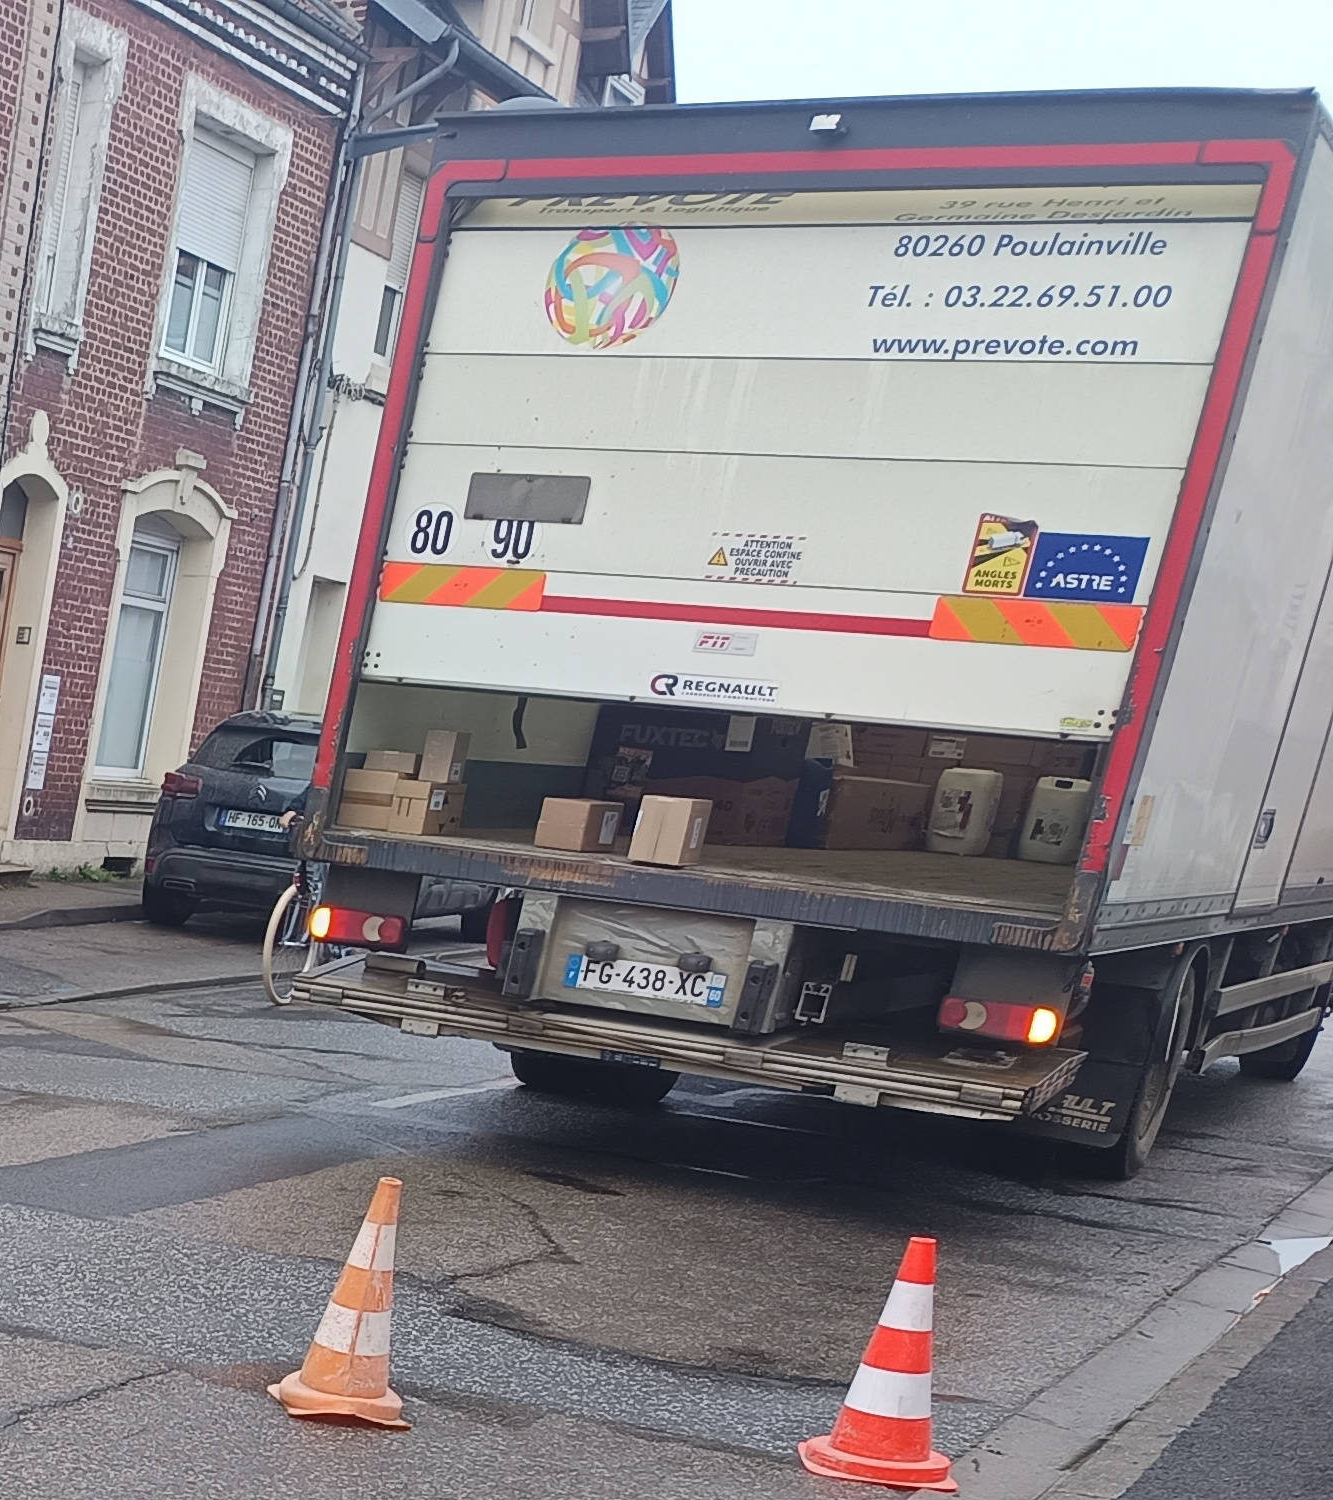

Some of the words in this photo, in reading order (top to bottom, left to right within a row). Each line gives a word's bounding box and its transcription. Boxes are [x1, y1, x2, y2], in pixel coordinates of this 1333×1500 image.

[983, 199, 1033, 209] rue
[1042, 196, 1127, 208] Henri
[1047, 207, 1193, 222] Desjardin
[893, 234, 985, 258] 80260
[992, 231, 1168, 257] Poulainville
[866, 285, 911, 308] Tél.
[924, 292, 934, 308] :
[944, 285, 1173, 308] 03.22.69.51.00
[871, 335, 1139, 359] www.prevote.com
[410, 509, 454, 556] 80
[491, 519, 535, 560] 90
[743, 539, 793, 550] ATTENTION
[729, 547, 763, 558] ESPACE
[763, 550, 803, 561] CONFINE
[734, 557, 768, 568] OUVRIR
[769, 560, 793, 569] AVEC
[733, 567, 789, 578] PRECAUTION
[974, 569, 1017, 579] ANGLES
[974, 579, 1013, 589] MORTS
[1049, 573, 1114, 591] ASTRE
[683, 679, 779, 697] REGNAULT
[582, 959, 707, 998] FG-438-XC
